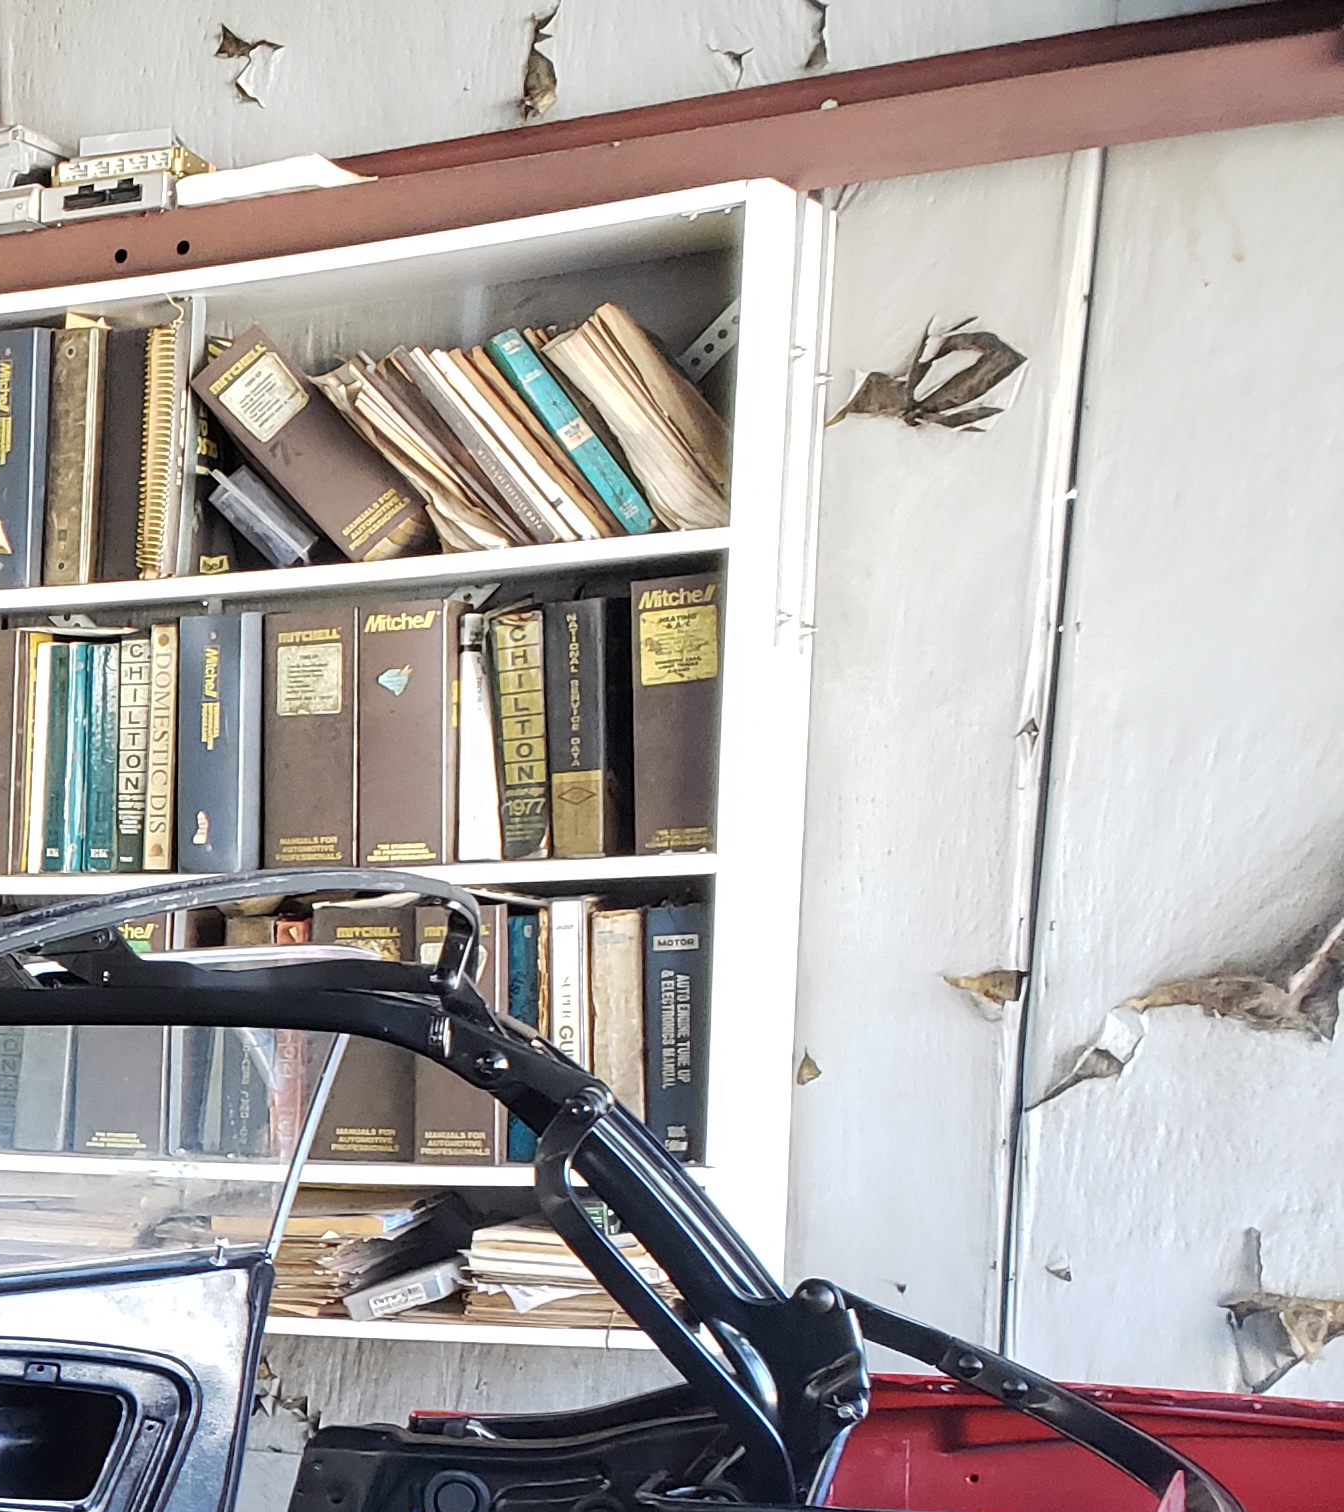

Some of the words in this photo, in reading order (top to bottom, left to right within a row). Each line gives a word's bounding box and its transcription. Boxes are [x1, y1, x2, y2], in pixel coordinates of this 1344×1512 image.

[209, 343, 268, 395] MITCHELL
[638, 584, 716, 610] Mitchell
[278, 628, 341, 643] MITCHELL
[364, 610, 437, 633] Mitchell
[566, 613, 580, 673] NATIONAL
[204, 648, 219, 699] Mitchell
[124, 643, 144, 791] CHILTON
[150, 651, 172, 786] DOMESTIC
[509, 625, 535, 783] CHILTON
[570, 738, 581, 767] DATA
[149, 795, 167, 834] DIS
[505, 798, 547, 816] 1977
[336, 926, 401, 938] MITCHELL
[657, 937, 695, 947] MOTOR
[677, 974, 691, 1002] AUTO
[661, 980, 675, 1045] ELECTRONICS
[677, 1004, 691, 1039] ENGINE
[661, 1047, 676, 1090] MANUAL
[677, 1041, 691, 1067] TUNE
[677, 1069, 691, 1084] UP
